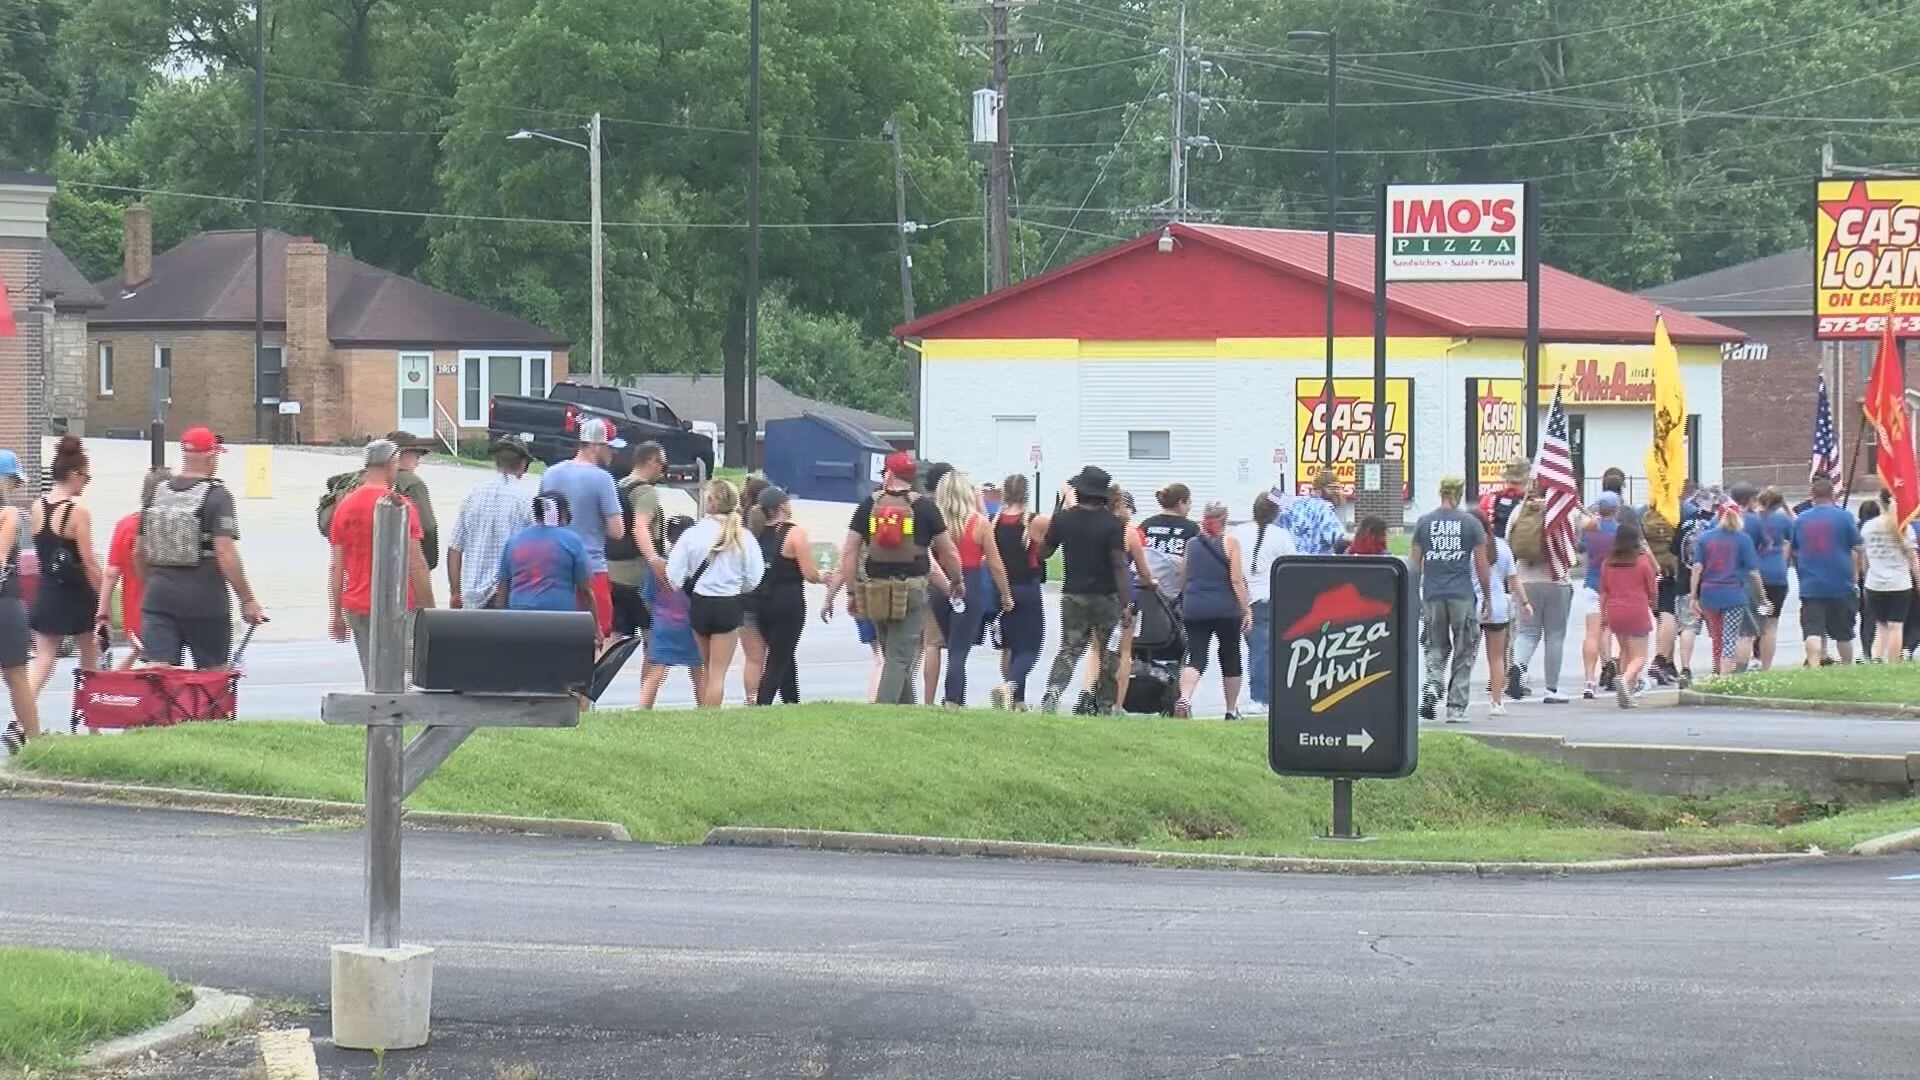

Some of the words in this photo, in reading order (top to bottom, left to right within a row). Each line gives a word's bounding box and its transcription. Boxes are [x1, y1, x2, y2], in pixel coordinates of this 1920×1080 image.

[1392, 199, 1516, 234] IMO'S
[1836, 206, 1920, 247] CAS
[1397, 239, 1511, 252] PIZZA
[1392, 259, 1441, 267] Sandwiches
[1450, 259, 1479, 267] Salads
[1487, 259, 1515, 267] Pastas
[1828, 293, 1853, 307] ON
[1483, 402, 1517, 432] CASH
[1480, 432, 1521, 463] LOANS
[1430, 520, 1462, 535] EARN
[1431, 536, 1462, 550] YOUR
[1425, 550, 1467, 561] SWEAT
[1286, 621, 1391, 689] Pizza
[1305, 648, 1382, 700] Hut
[1299, 732, 1341, 747] Enter
